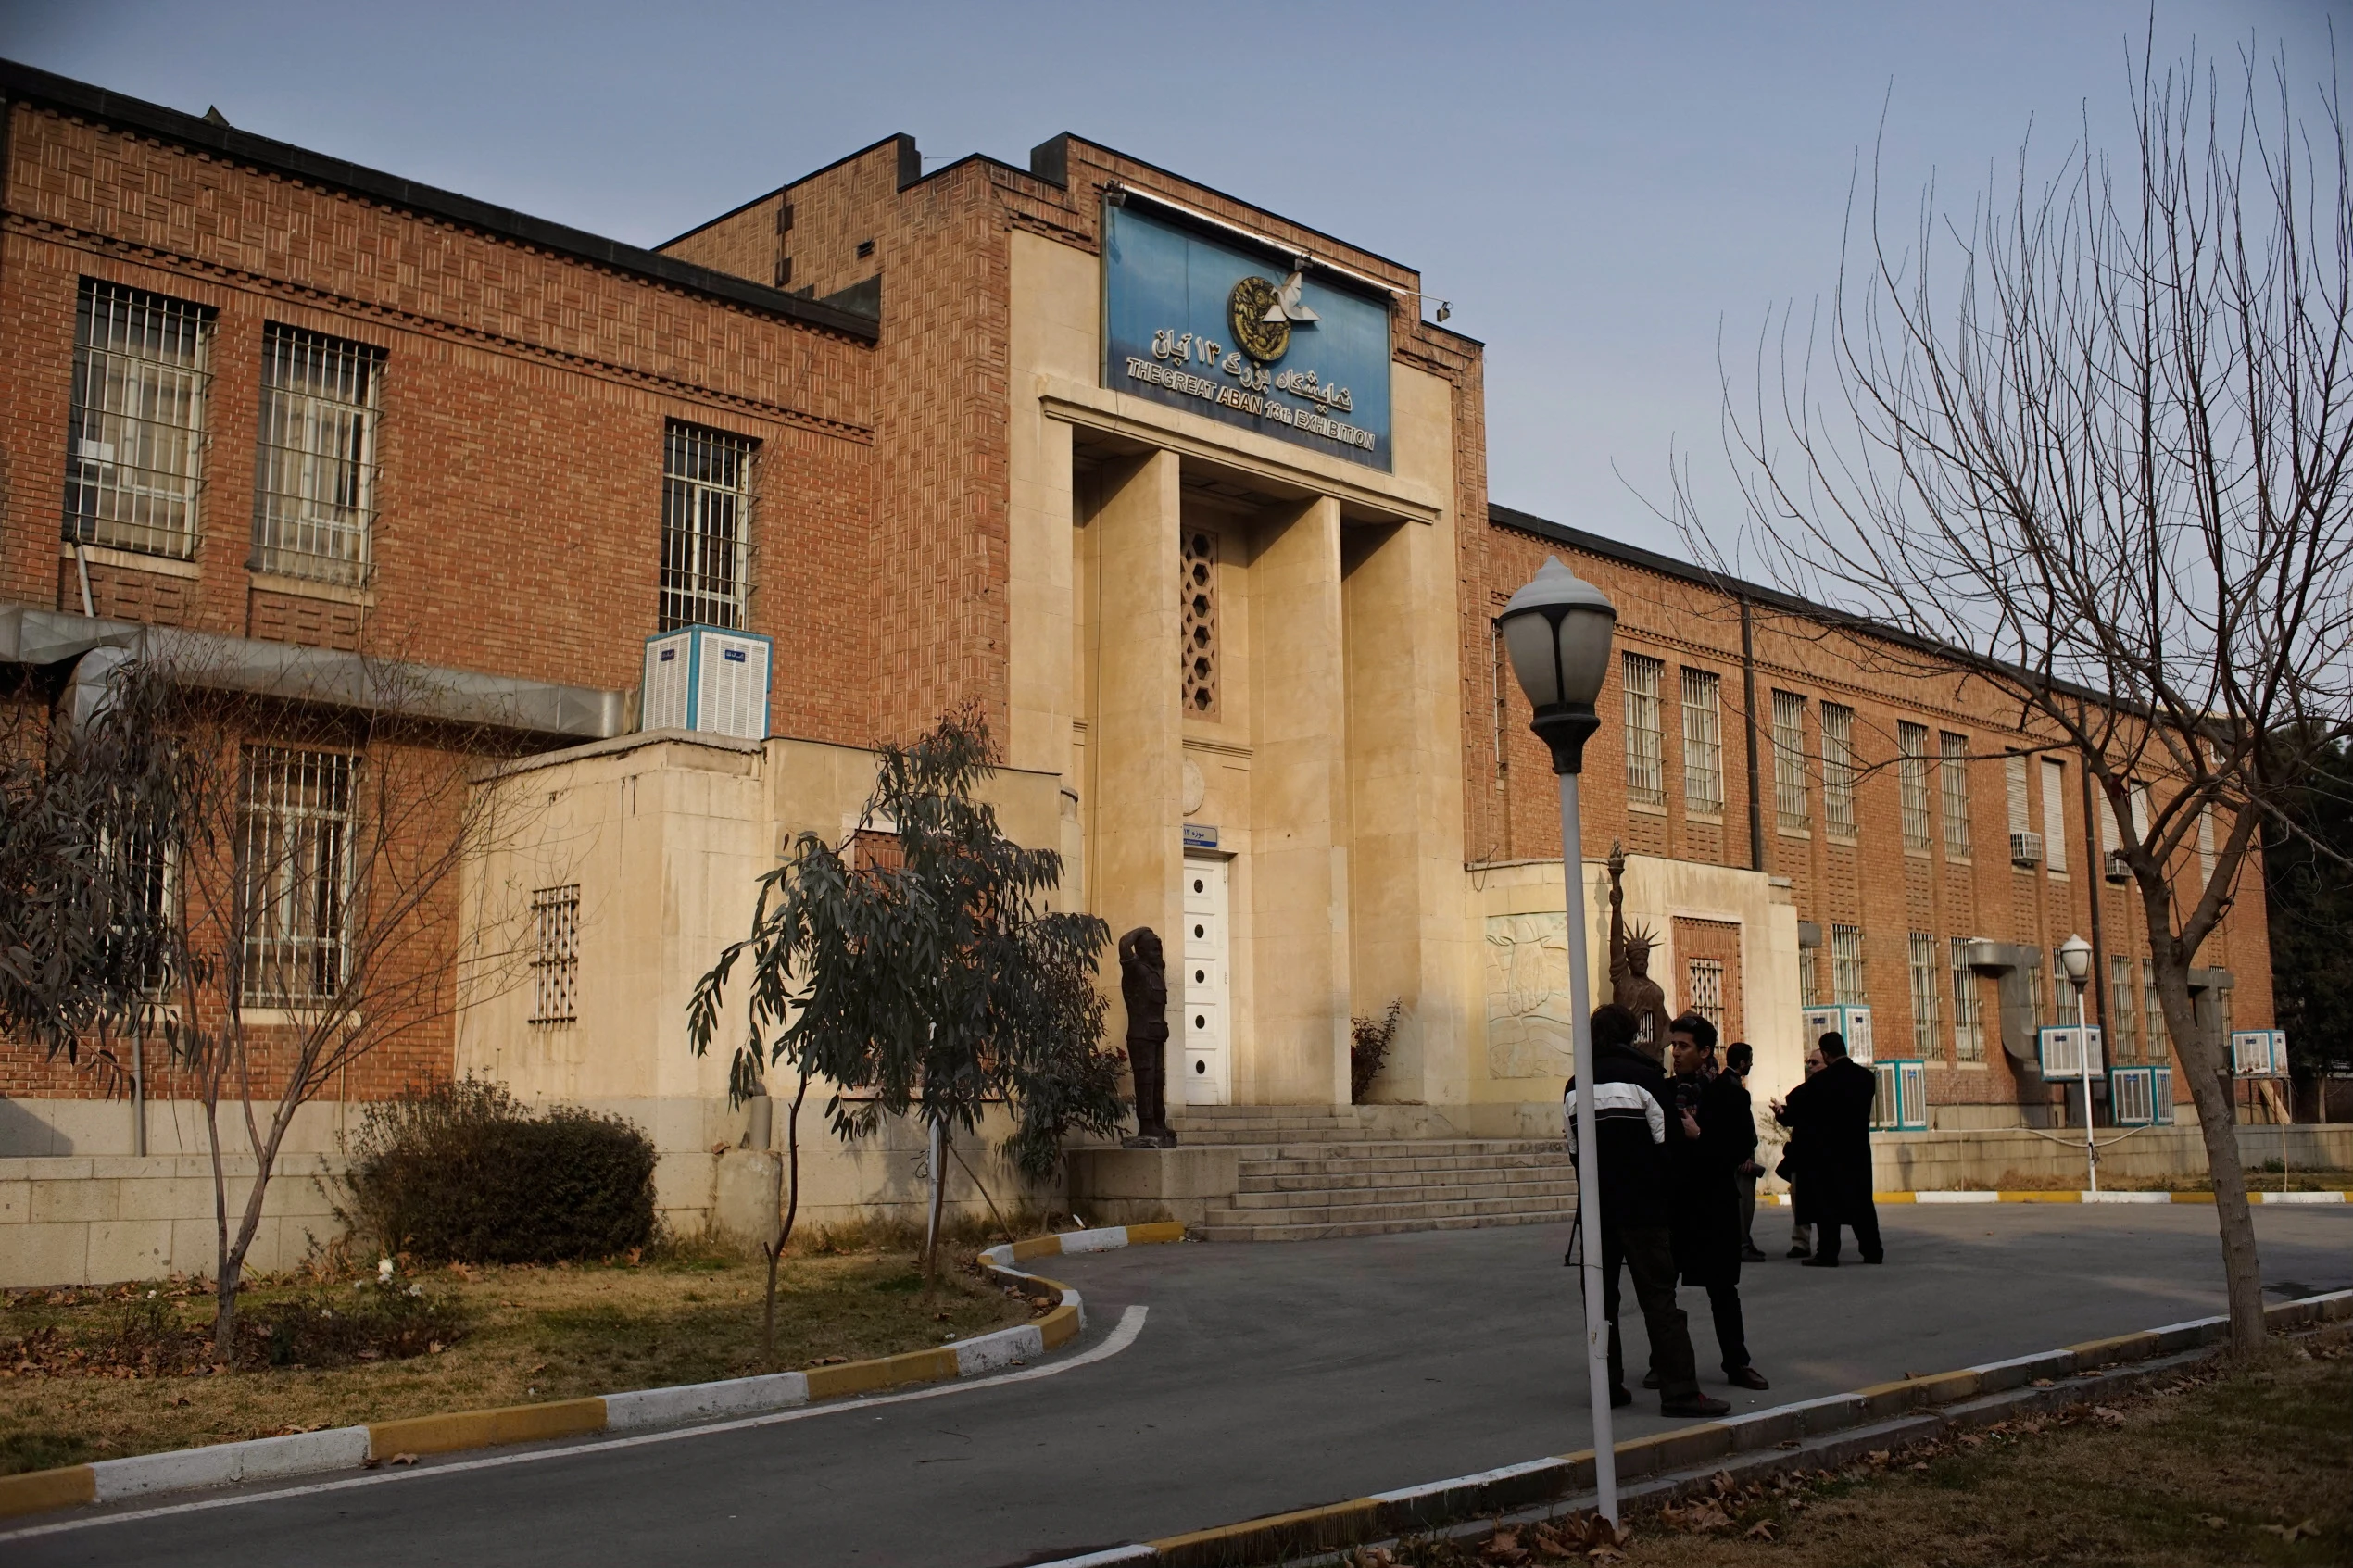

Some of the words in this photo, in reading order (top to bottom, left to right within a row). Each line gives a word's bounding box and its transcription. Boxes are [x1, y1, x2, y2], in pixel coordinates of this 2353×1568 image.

[1151, 330, 1193, 367] آبان
[1195, 336, 1221, 366] ۱۳
[1222, 352, 1272, 395] بزرگ
[1275, 369, 1353, 414] نمایشگاه
[1216, 385, 1263, 415] ABAN
[1265, 400, 1293, 425] 13th
[1293, 408, 1375, 451] EXHIBITION
